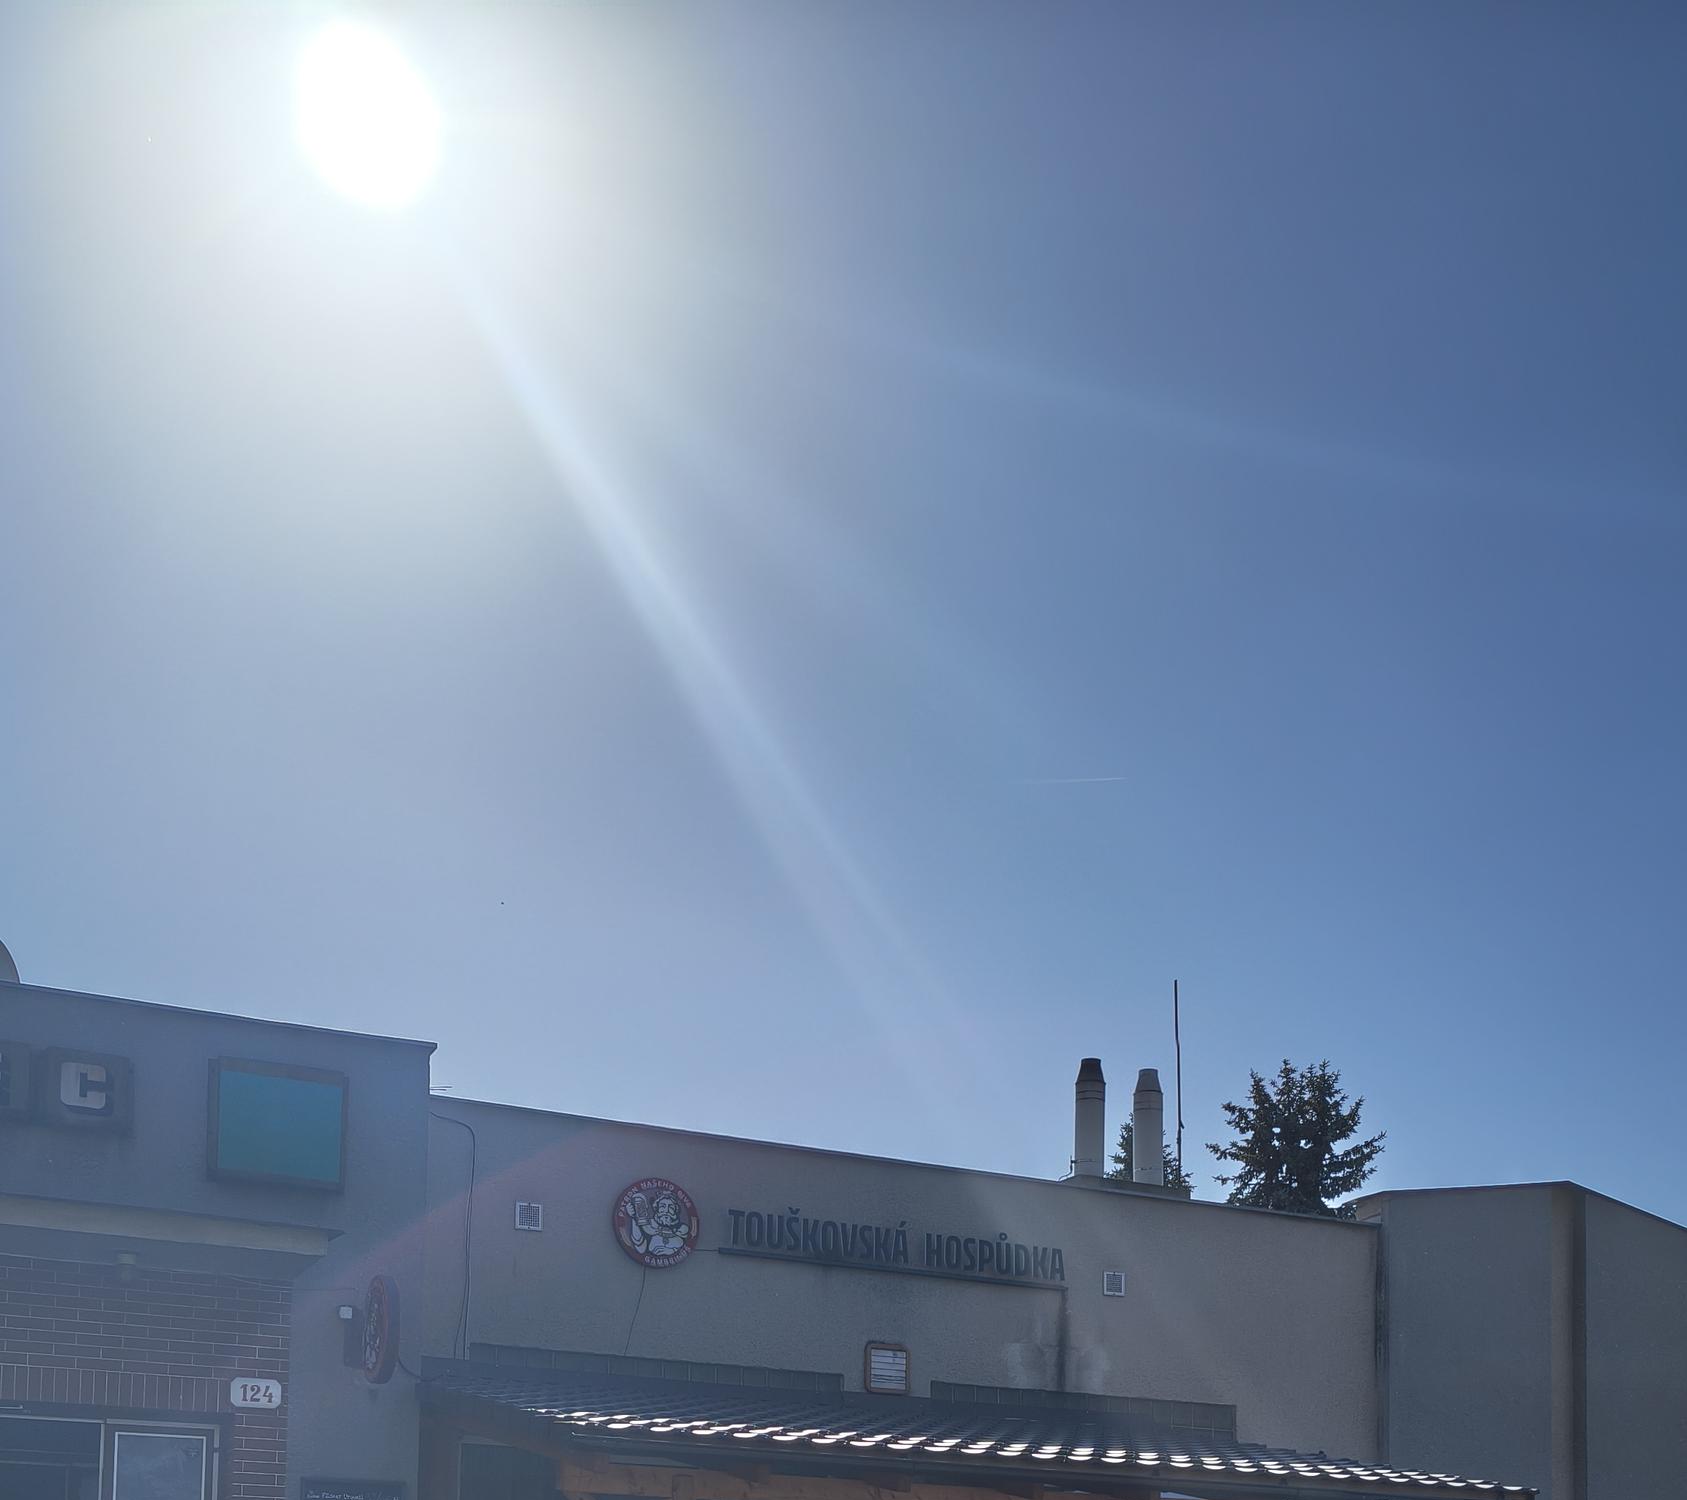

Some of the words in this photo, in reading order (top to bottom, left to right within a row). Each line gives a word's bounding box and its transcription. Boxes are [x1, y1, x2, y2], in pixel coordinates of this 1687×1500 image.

[728, 1206, 910, 1265] TOUŠKOVSKÁ
[925, 1233, 1066, 1282] HOSPŮDKA
[240, 1384, 273, 1403] 124
